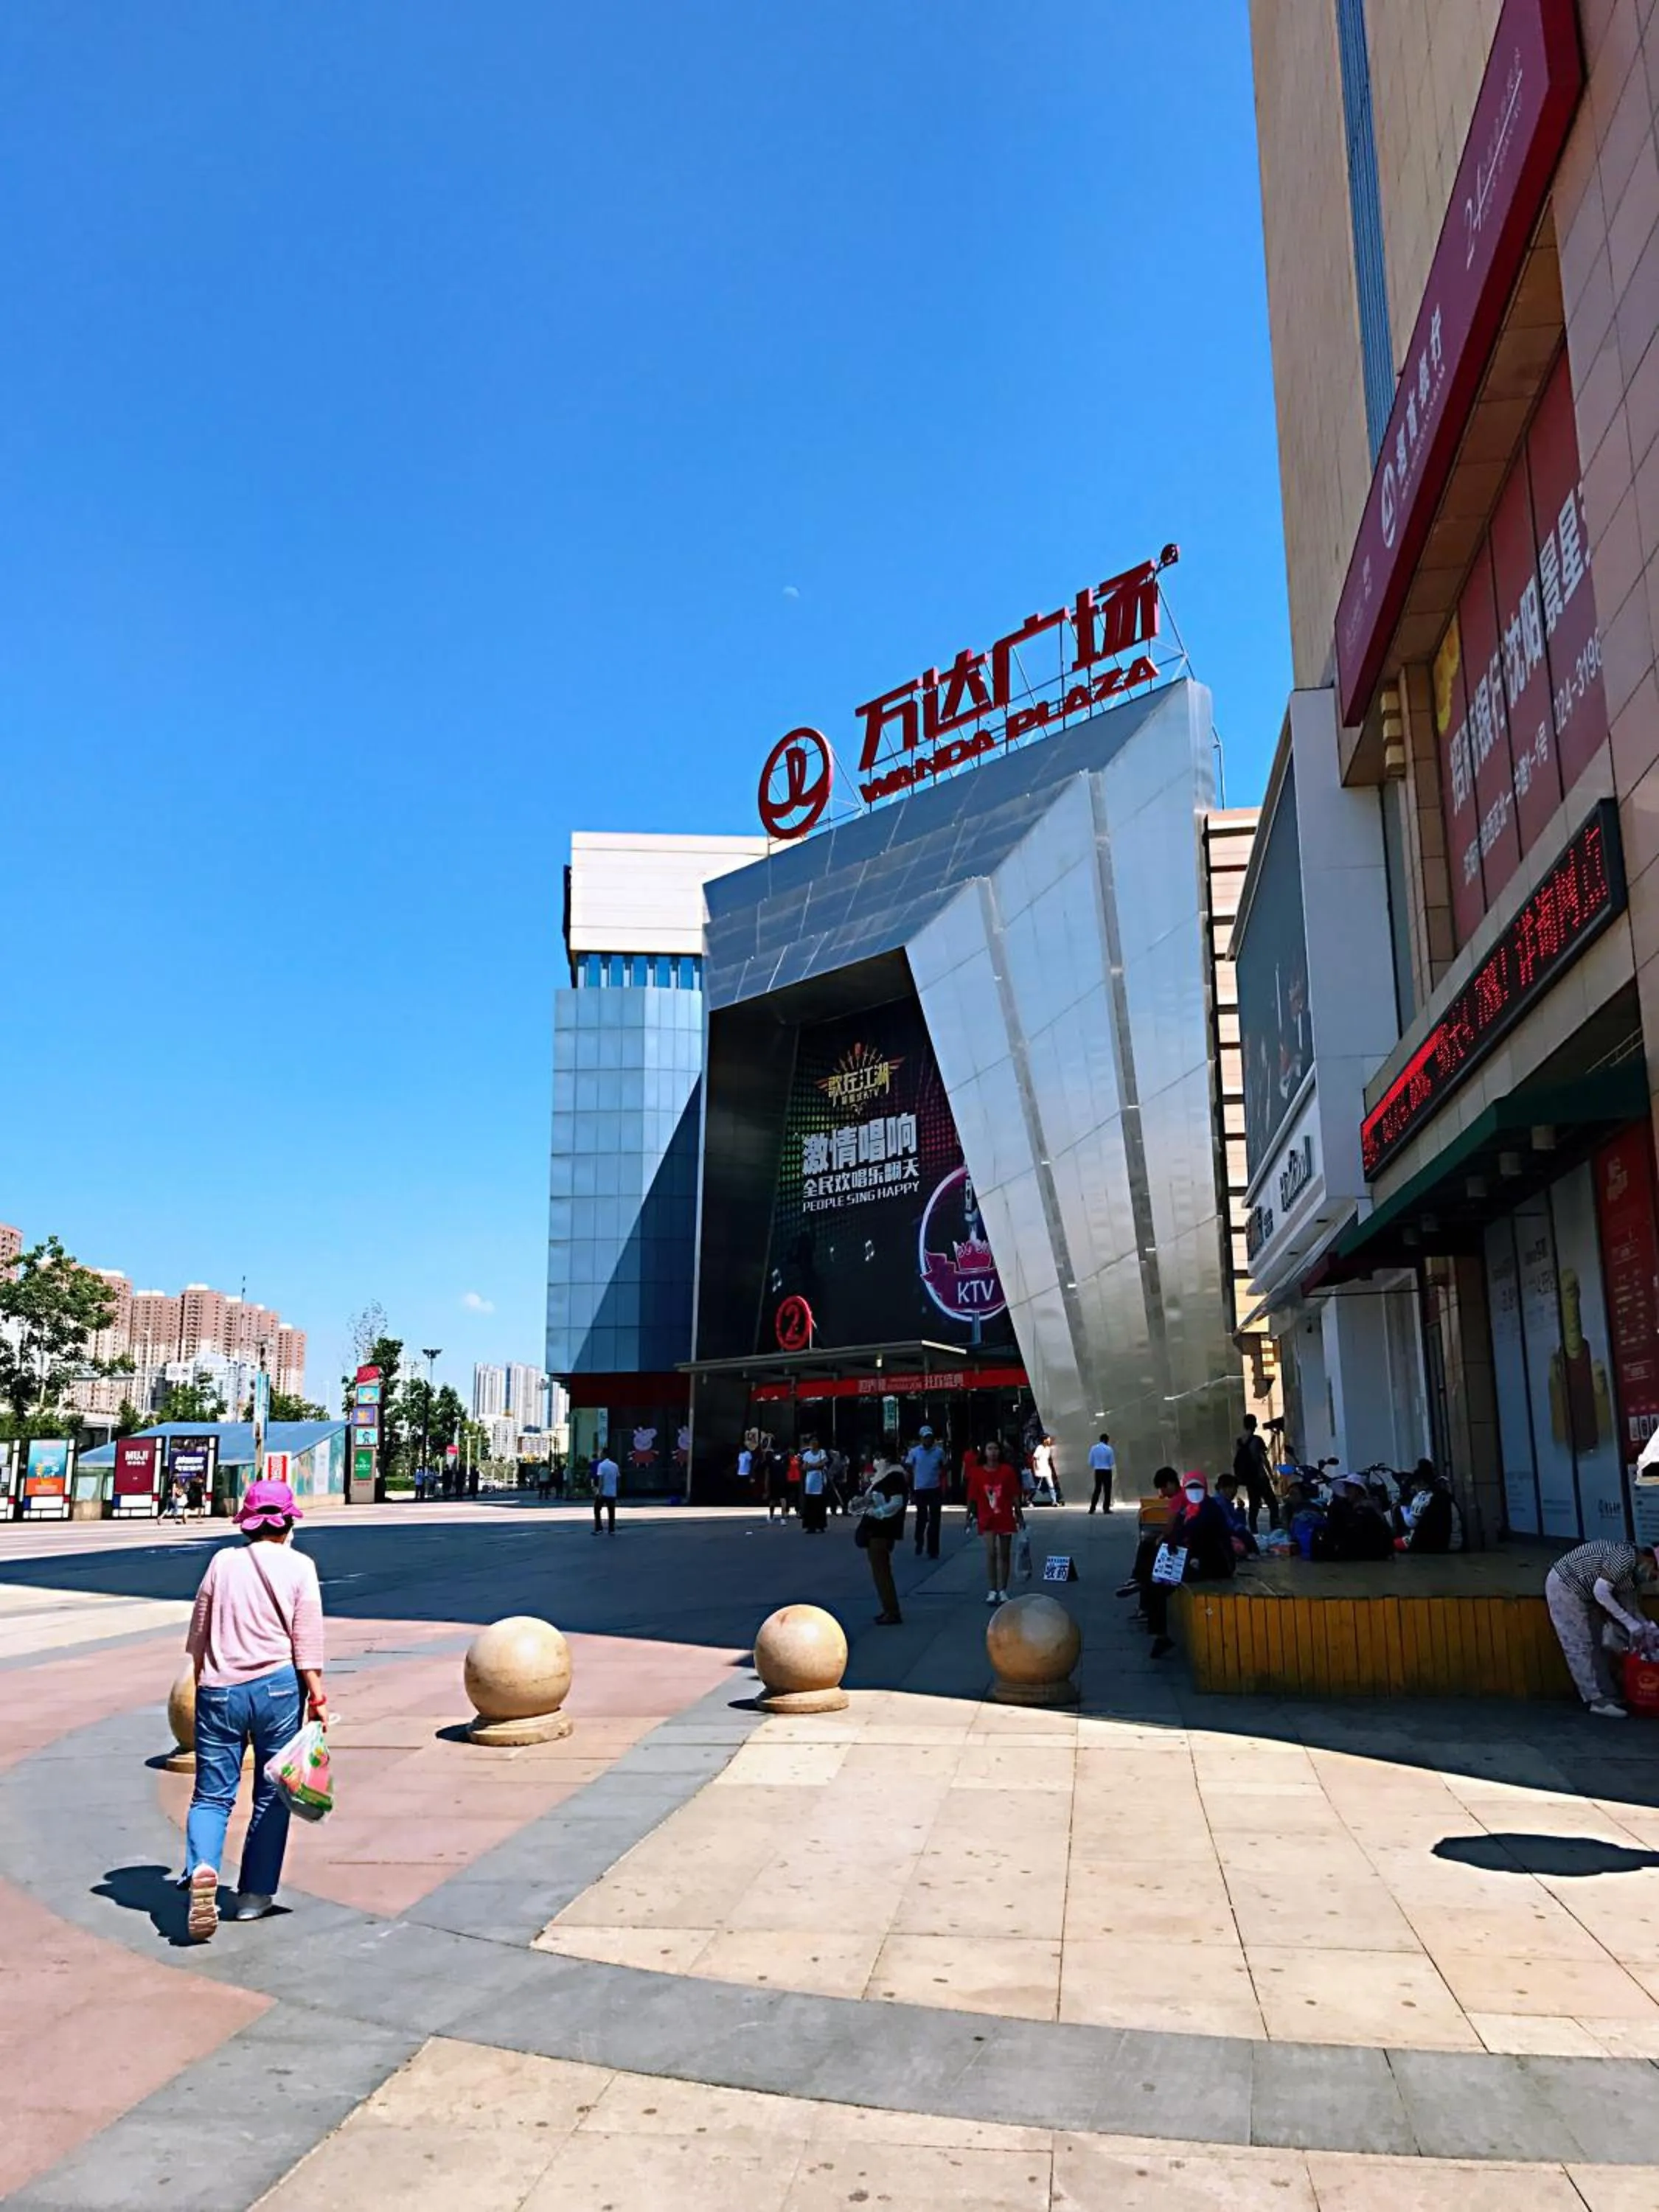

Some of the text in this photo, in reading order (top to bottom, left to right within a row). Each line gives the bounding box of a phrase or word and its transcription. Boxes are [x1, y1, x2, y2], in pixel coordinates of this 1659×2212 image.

[855, 559, 1159, 771] 万达广场
[1450, 478, 1590, 816] 招商银行沈阳景星
[860, 655, 1160, 803] WANDA PLAZA
[827, 1061, 890, 1107] 歌在江湖
[802, 1112, 917, 1175] 激情唱响
[802, 1158, 920, 1198] 全民欢唱乐翻天
[802, 1180, 920, 1213] PEOPLE SING HAPPY
[958, 1280, 995, 1304] KTV
[785, 1304, 801, 1341] 2
[125, 1450, 149, 1461] MUJI
